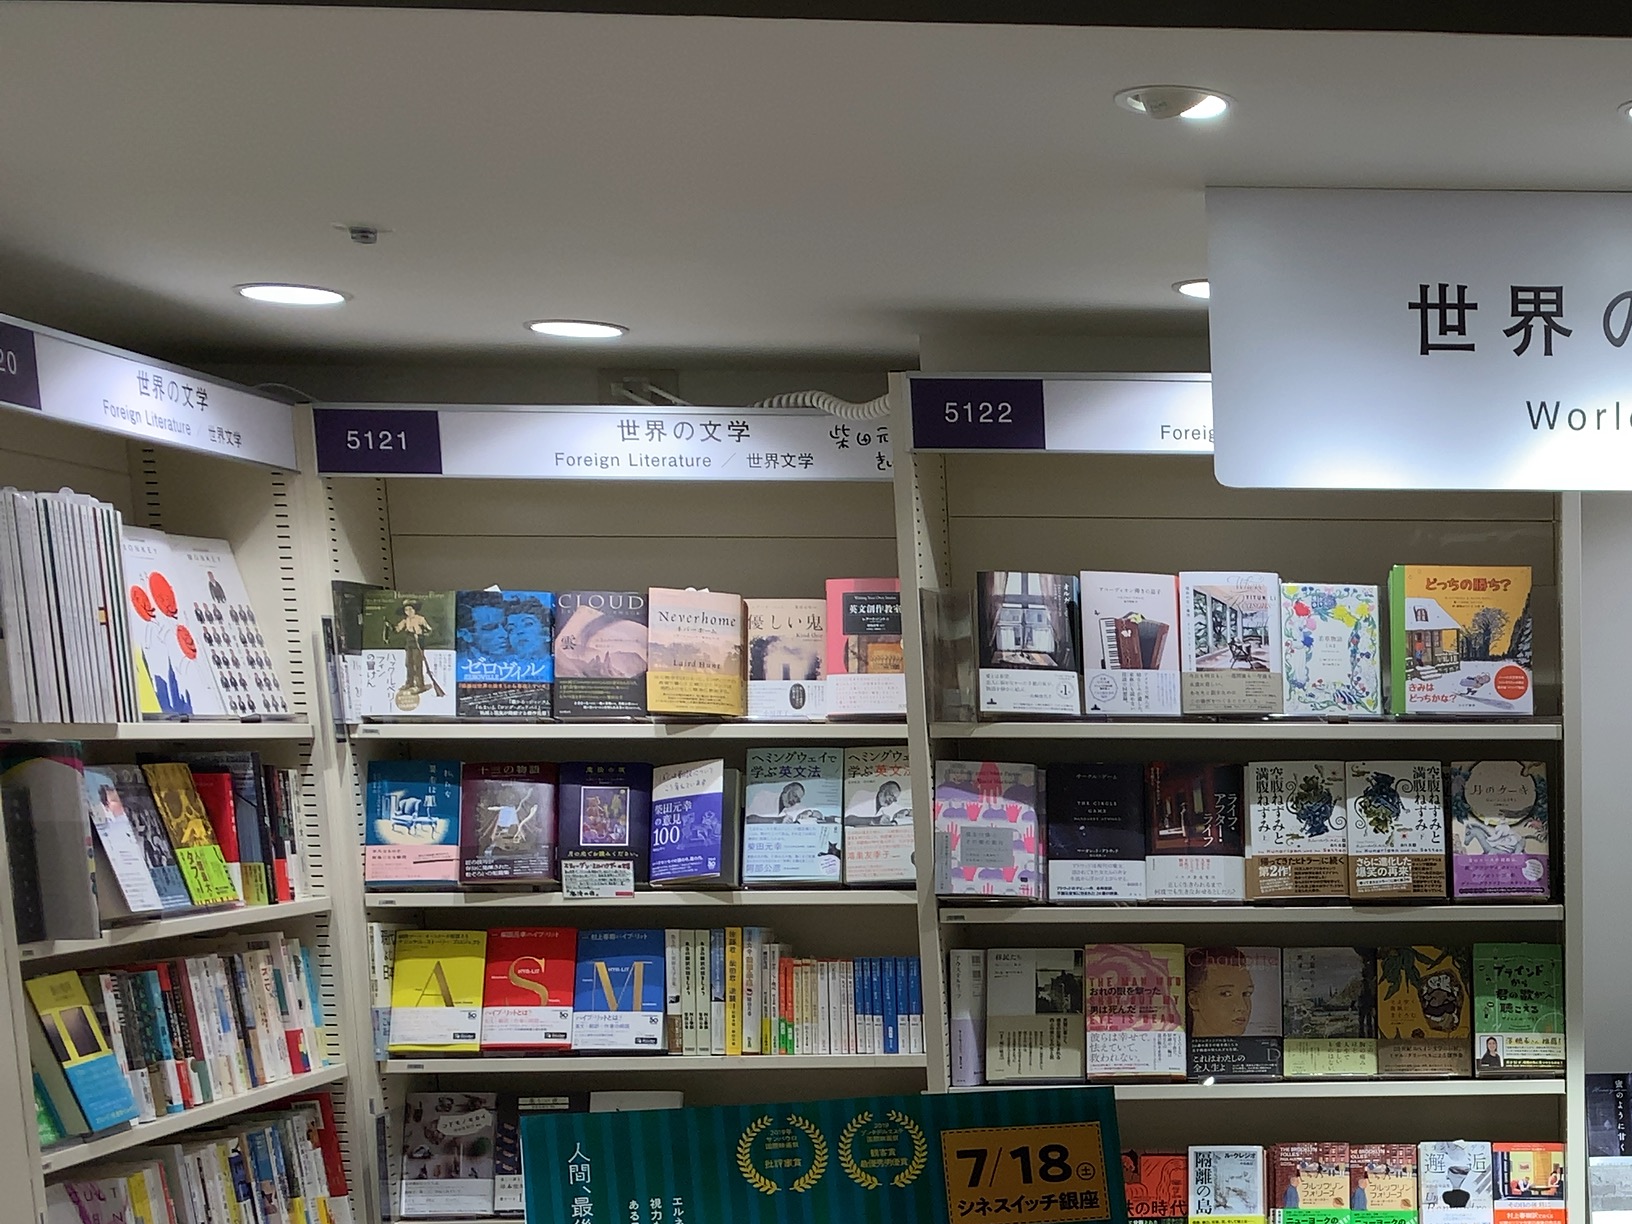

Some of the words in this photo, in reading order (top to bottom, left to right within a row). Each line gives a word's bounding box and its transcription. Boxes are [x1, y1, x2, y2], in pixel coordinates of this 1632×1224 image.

[137, 370, 209, 411] 世界の文学
[944, 401, 1012, 424] 5122
[103, 399, 142, 426] Foreign
[145, 408, 192, 437] Literature
[208, 424, 242, 449] 世界文学
[617, 419, 751, 443] 世界の文学
[346, 430, 408, 451] 5121
[554, 451, 621, 471] Foreign
[628, 451, 712, 468] Literature
[746, 452, 814, 469] 世界文学
[1425, 577, 1512, 592] どっちの勝ち?
[557, 594, 645, 610] CLOUD
[849, 604, 904, 615] 英文創作教室
[658, 611, 737, 628] Neverhome
[461, 658, 546, 682] ゼロヴィル
[672, 658, 694, 669] Laird
[698, 660, 722, 670] Hunt
[1408, 683, 1435, 692] きみは
[1408, 693, 1457, 704] どっちかな?
[751, 751, 838, 765] ヘミングウェイで
[751, 765, 822, 780] 学ぶ英文法
[655, 799, 693, 814] 柴田元幸
[1255, 767, 1271, 833] 満腹ねずみ
[1269, 767, 1284, 845] 空腹ねずみと
[1413, 766, 1428, 832] 満腹ねずみ
[1426, 767, 1441, 845] 空腹ねずみと
[655, 814, 682, 827] の意見
[1213, 793, 1225, 842] アフター・
[1227, 794, 1238, 831] ライフ・
[652, 825, 681, 847] 100
[1202, 813, 1213, 847] ライフ
[1089, 986, 1162, 996] おれの眼を撃った
[1089, 1005, 1137, 1015] 男は死んだ
[1613, 1078, 1627, 1153] 蜜のように甘く
[764, 1158, 802, 1169] 批評家賞
[869, 1147, 896, 1158] 観客賞
[1424, 1151, 1487, 1174] 邂逅
[956, 1143, 1073, 1189] 7/18
[1195, 1151, 1213, 1215] 隔離の島
[956, 1189, 1101, 1217] シネスイッチ銀座
